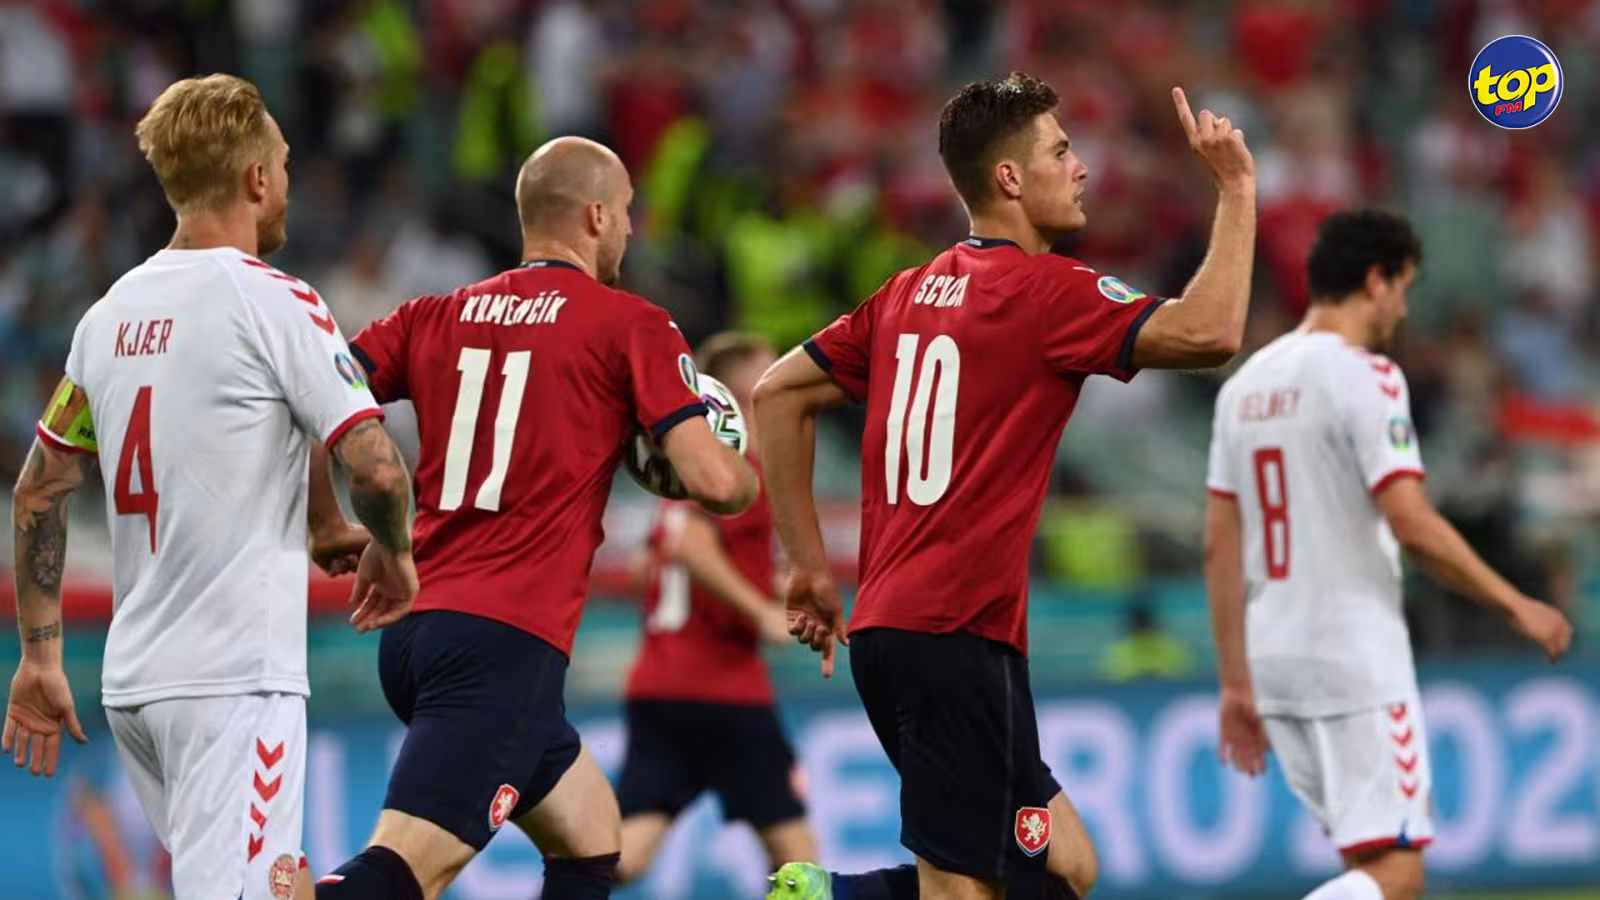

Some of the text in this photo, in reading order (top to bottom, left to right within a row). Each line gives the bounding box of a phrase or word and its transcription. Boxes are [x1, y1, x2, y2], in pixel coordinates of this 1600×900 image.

[114, 318, 174, 357] KJÆR
[885, 333, 961, 506] 10
[114, 386, 158, 554] 4
[438, 347, 531, 512] 11
[1254, 447, 1290, 580] 8
